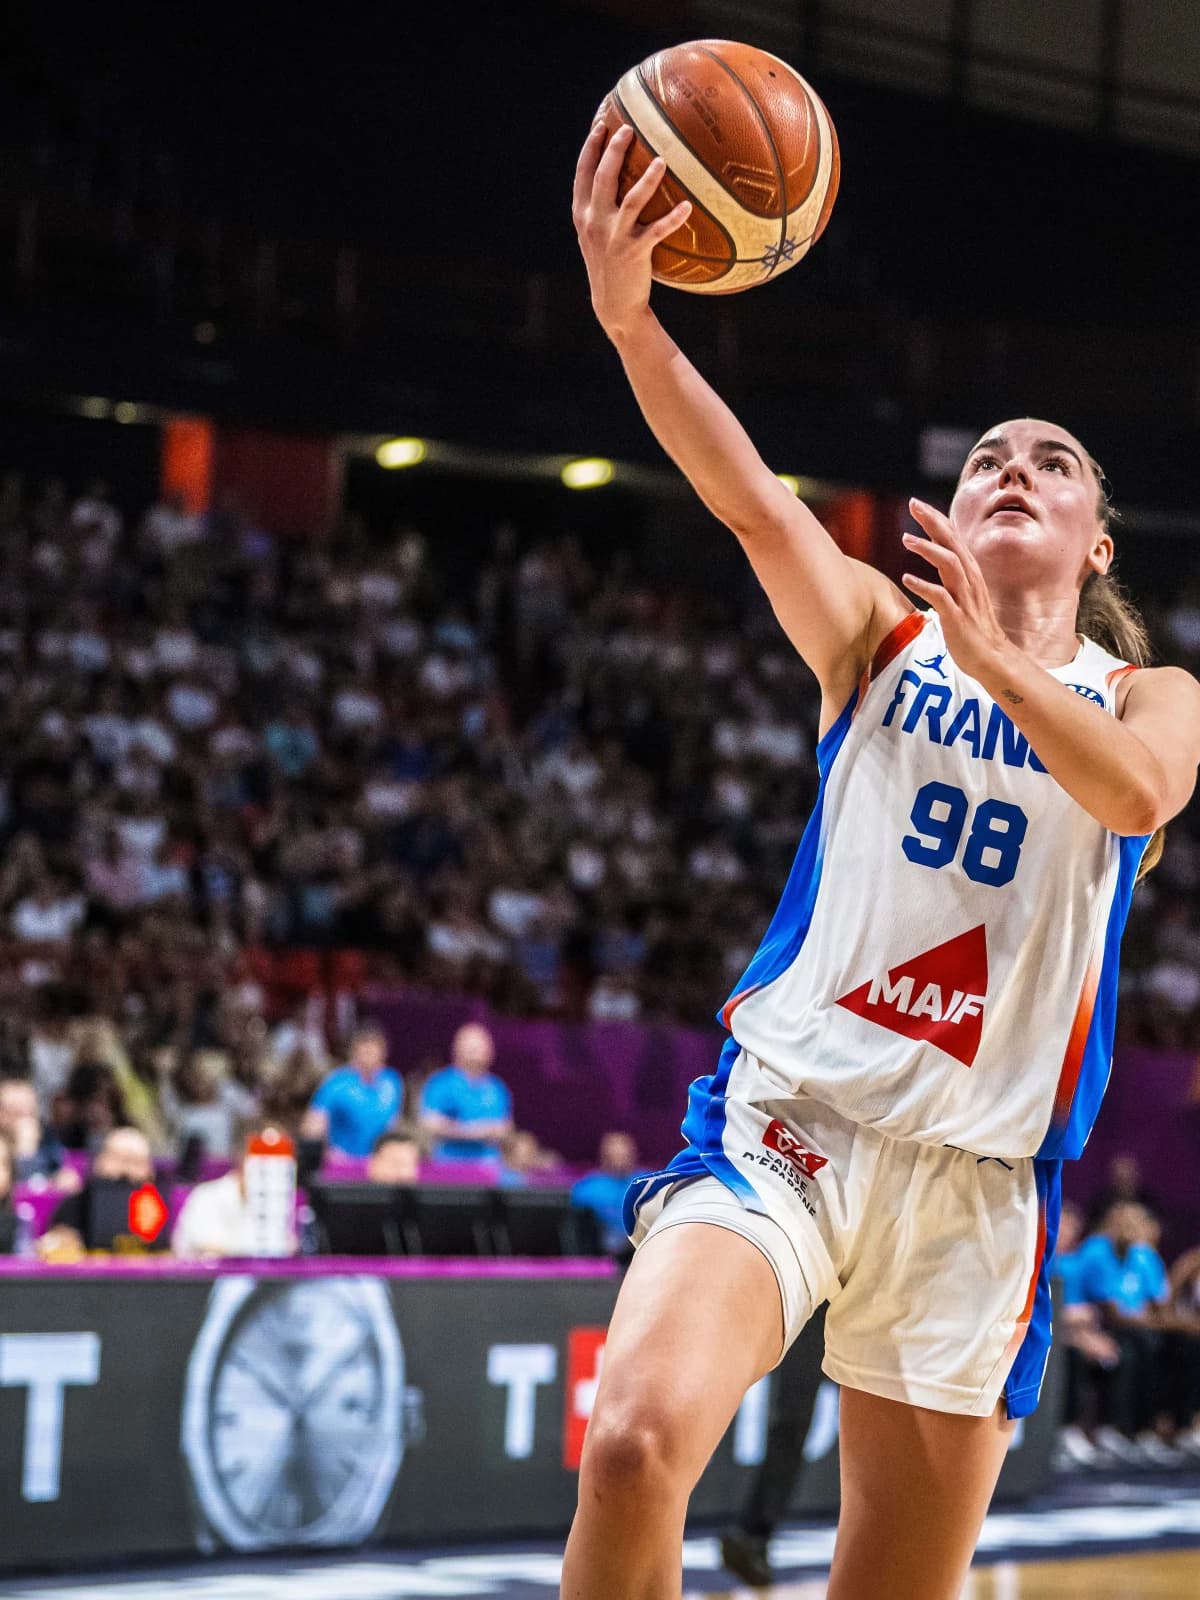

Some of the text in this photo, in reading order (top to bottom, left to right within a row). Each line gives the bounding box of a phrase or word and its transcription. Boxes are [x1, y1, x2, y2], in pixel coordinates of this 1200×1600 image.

[882, 668, 1050, 774] FRAN
[901, 780, 1028, 888] 98
[866, 974, 985, 1025] MAIF
[766, 1150, 808, 1194] CAISSE
